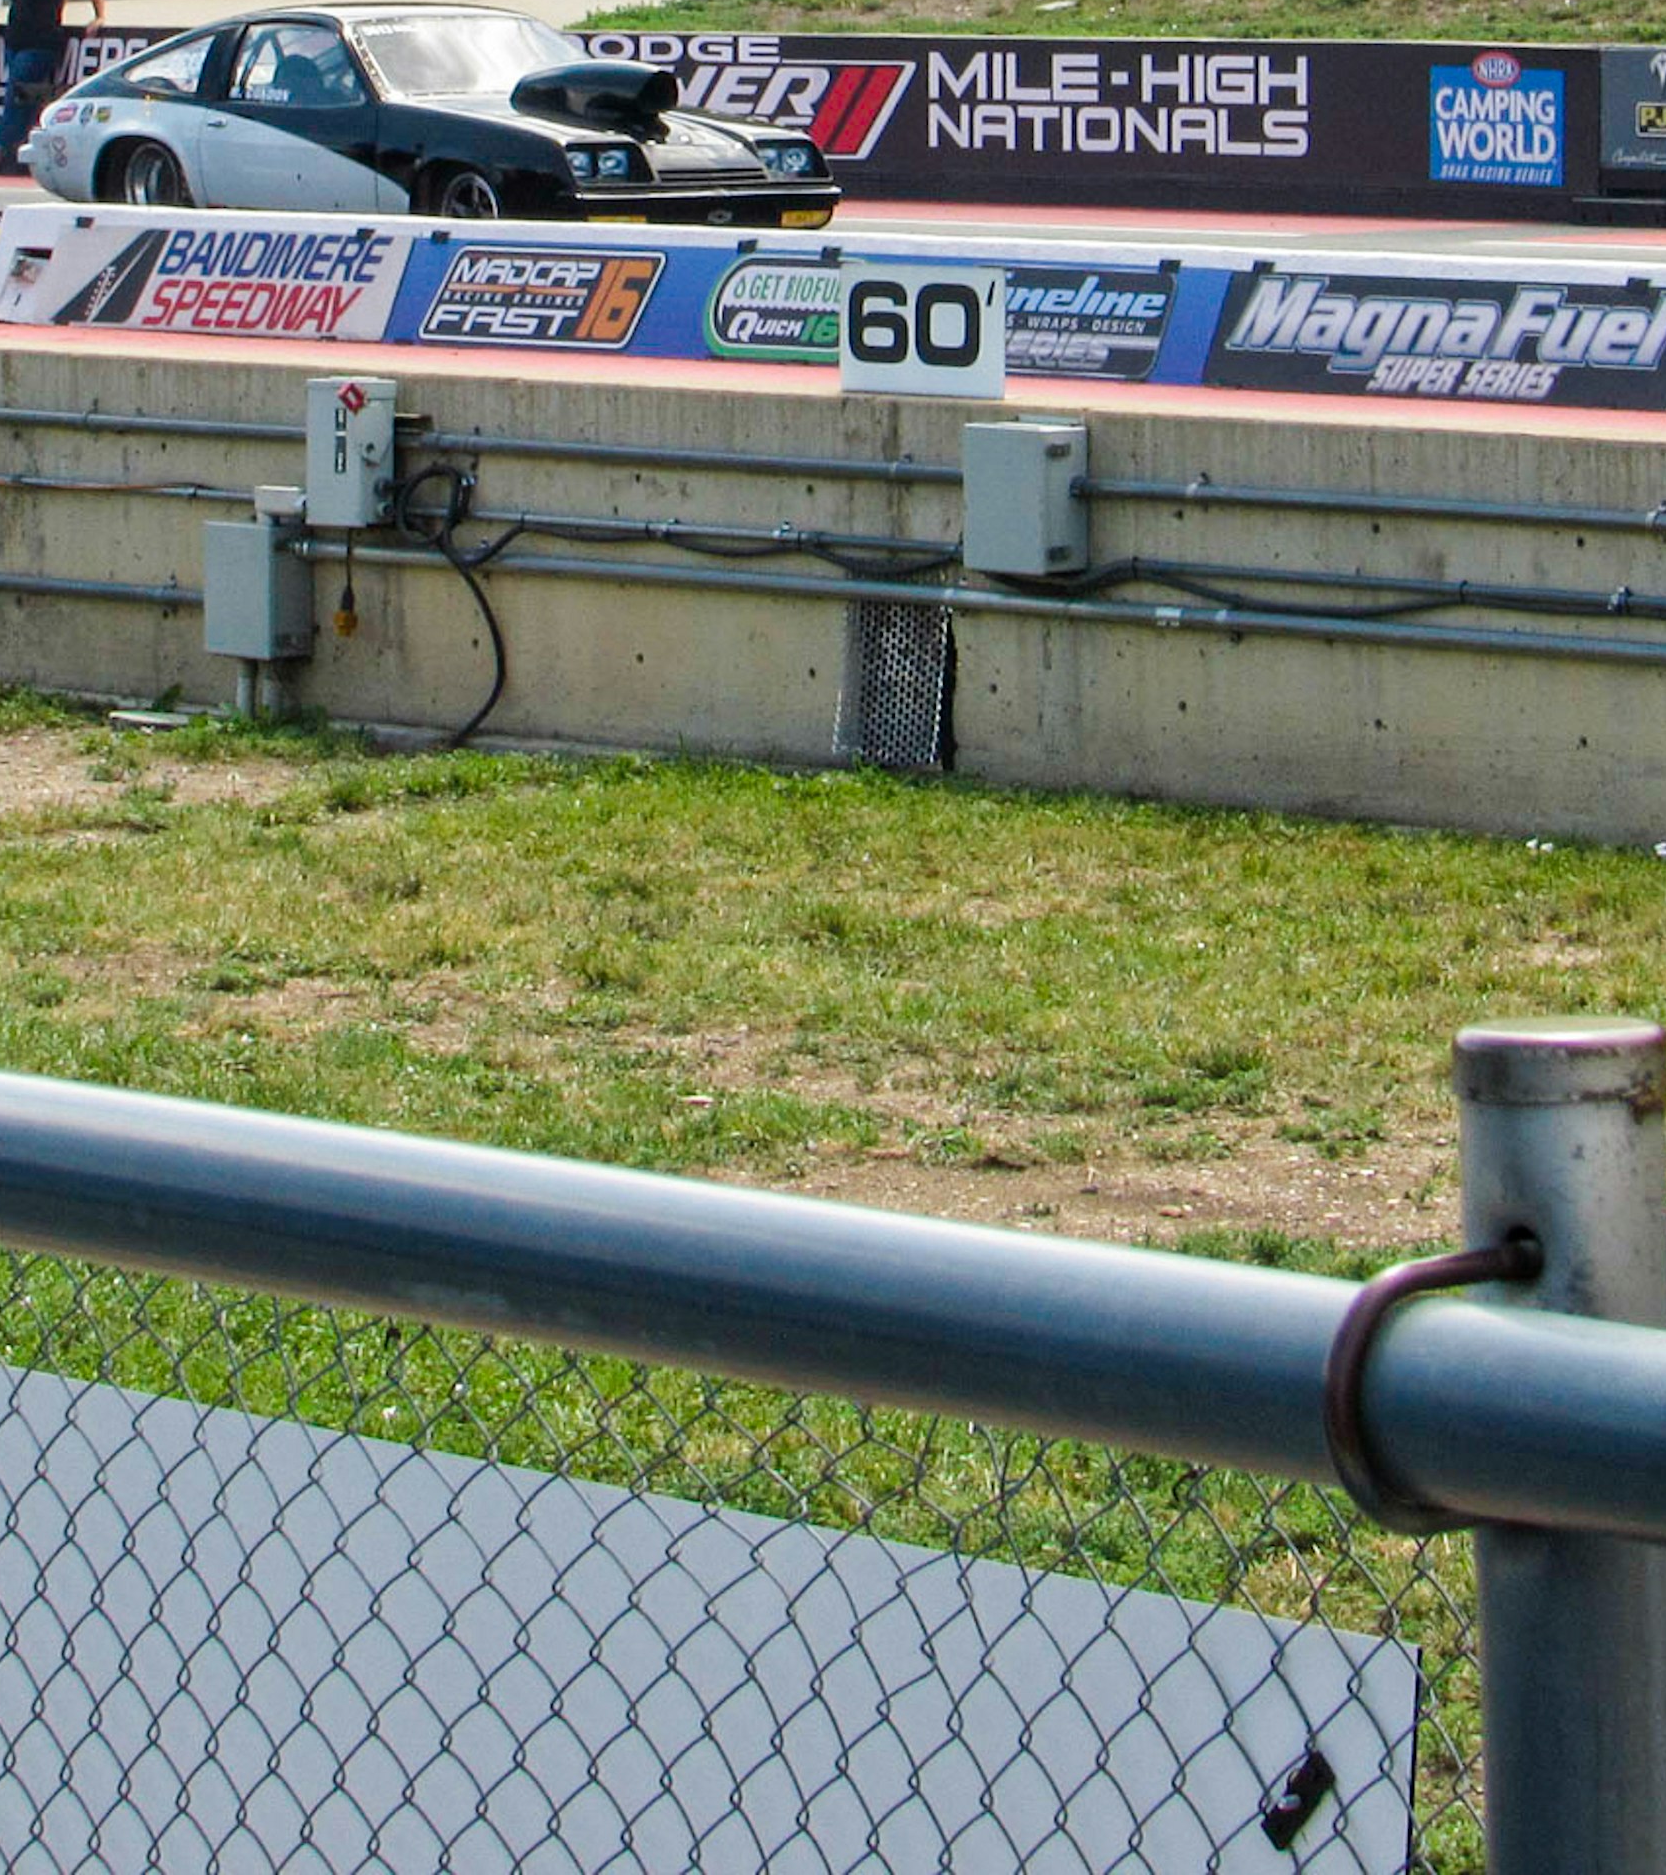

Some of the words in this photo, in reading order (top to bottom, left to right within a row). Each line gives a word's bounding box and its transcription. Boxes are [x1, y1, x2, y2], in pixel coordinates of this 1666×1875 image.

[576, 34, 781, 64] ODGE
[1475, 58, 1519, 83] NHRA
[1435, 87, 1555, 124] CAMPING
[928, 102, 1309, 157] NATIONALS
[1436, 119, 1557, 163] WORLD
[1472, 165, 1512, 182] RACING
[1514, 168, 1553, 184] SERIES
[158, 230, 394, 283] BANDIMERE
[449, 258, 601, 286] MADCAP
[428, 305, 581, 337] FAST
[574, 259, 655, 340] 16
[749, 273, 784, 300] GET
[142, 279, 363, 333] SPEEDWAY
[1027, 316, 1079, 331] WRAPS
[1092, 320, 1146, 334] DESIGN
[1006, 329, 1109, 361] ERIES
[1367, 356, 1464, 396] SUPER
[1458, 359, 1565, 400] SERIES
